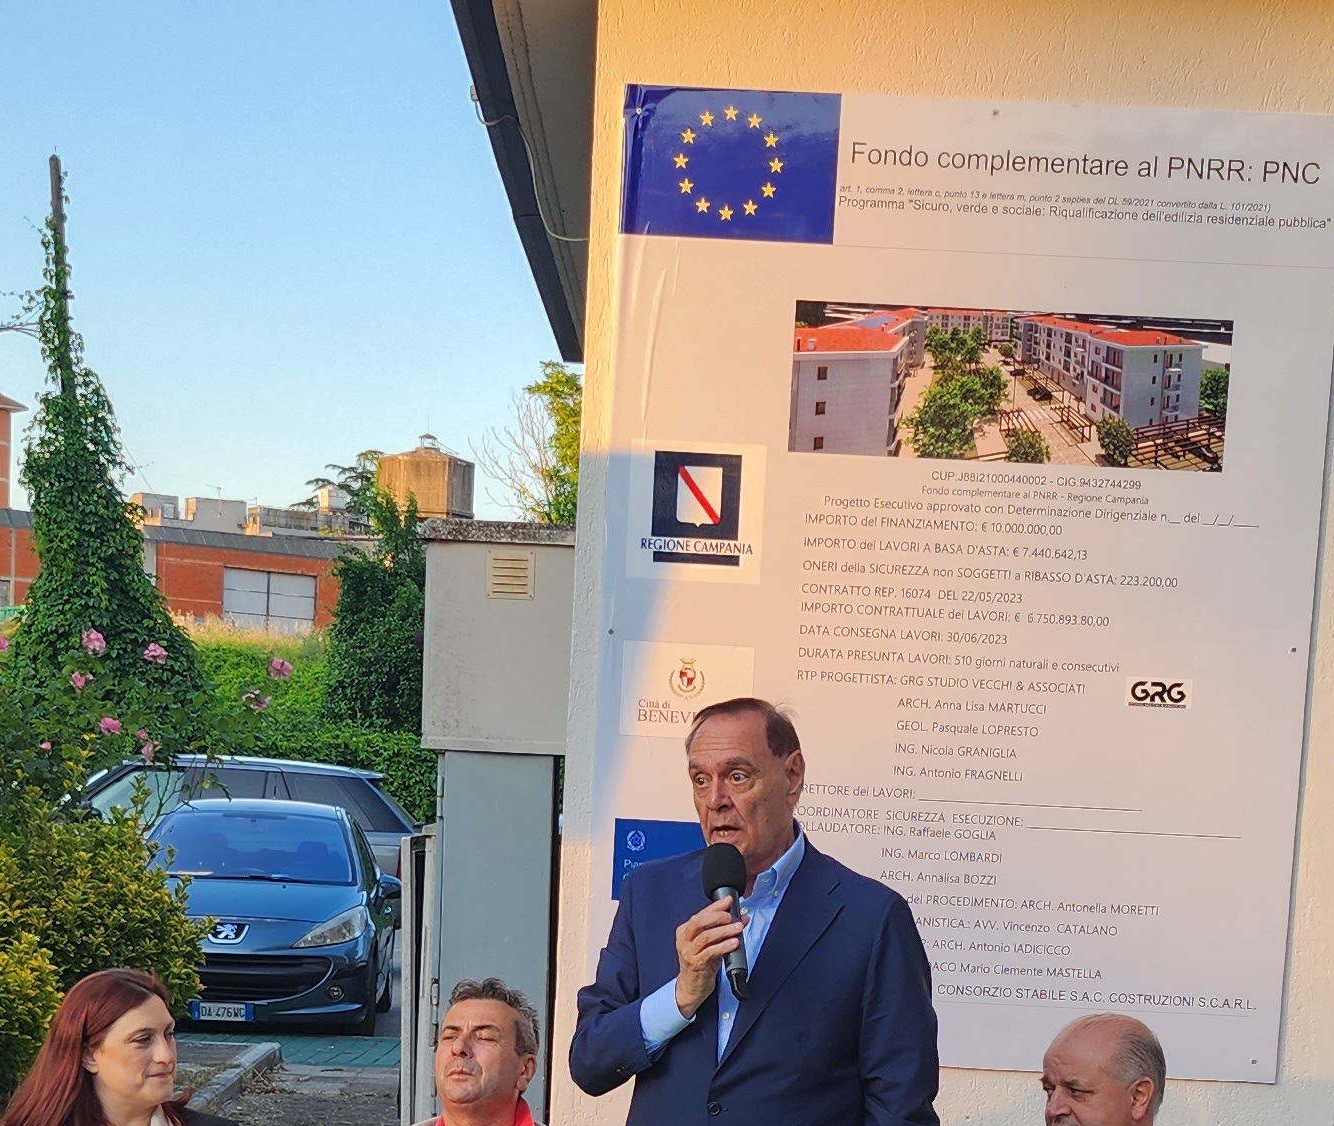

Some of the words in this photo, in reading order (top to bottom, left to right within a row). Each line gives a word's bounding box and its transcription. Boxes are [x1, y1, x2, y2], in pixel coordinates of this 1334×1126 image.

[851, 141, 929, 168] Fondo
[938, 149, 1129, 177] complementare
[1137, 155, 1159, 178] al
[1167, 156, 1253, 182] PNRR:
[1262, 160, 1321, 185] PNC
[944, 190, 968, 200] punto
[1029, 193, 1053, 204] punto
[1157, 199, 1197, 209] convertito
[838, 195, 906, 211] Programma
[909, 198, 953, 213] "Sicuro,
[956, 201, 989, 214] verde
[1002, 203, 1046, 216] sociale:
[1049, 205, 1139, 221] Riqualificazione
[1141, 210, 1203, 224] dell'edilizia
[1206, 212, 1275, 227] residenziale
[1278, 215, 1332, 229] pubblica"
[921, 485, 950, 496] Fondo
[952, 487, 1020, 500] complementare
[1033, 491, 1058, 501] PNRR
[1067, 493, 1103, 505] Regione
[1105, 494, 1149, 506] Campania
[824, 495, 870, 511] Progetto
[873, 497, 923, 511] Esecutivo
[926, 500, 982, 515] approvato
[984, 504, 1004, 515] con
[1007, 504, 1092, 519] Determinazione
[1095, 508, 1157, 523] Dirigenziale
[1183, 512, 1200, 524] del
[805, 513, 858, 526] IMPORTO
[861, 515, 878, 527] del
[880, 517, 978, 533] FINANZIAMENTO:
[991, 521, 1062, 536] 10.000.000,00
[641, 537, 691, 551] REGIONE
[694, 541, 754, 555] CAMPANIA
[803, 537, 857, 550] IMPORTO
[860, 538, 876, 551] dei
[879, 541, 920, 553] LAVORI
[923, 542, 932, 553] A
[934, 542, 964, 555] BASA
[966, 543, 1009, 557] D'ASTA:
[1022, 546, 1087, 560] 7.440.642,13
[803, 560, 838, 572] ONERI
[840, 561, 866, 574] della
[869, 563, 929, 576] SICUREZZA
[933, 568, 953, 578] non
[957, 567, 1011, 580] SOGGETTI
[1024, 571, 1071, 583] RIBASSO
[1074, 573, 1117, 586] D'ASTA:
[1120, 575, 1178, 589] 223.200,00
[801, 583, 871, 597] CONTRATTO
[874, 586, 898, 598] REP.
[901, 587, 931, 599] 16074
[938, 589, 958, 602] DEL
[961, 589, 1023, 604] 22/05/2023
[800, 601, 854, 615] IMPORTO
[856, 604, 945, 619] CONTRATTUALE
[947, 608, 964, 620] dei
[967, 610, 1011, 622] LAVORI:
[1027, 612, 1110, 627] 6.750.893.80,00
[799, 624, 830, 637] DATA
[833, 626, 897, 640] CONSEGNA
[900, 629, 943, 642] LAVORI:
[946, 631, 1008, 645] 30/06/2023
[798, 647, 844, 660] DURATA
[847, 650, 905, 663] PRESUNTA
[908, 653, 952, 665] LAVORI:
[954, 655, 973, 666] 510
[975, 656, 1006, 670] giorni
[1009, 658, 1049, 671] naturali
[1061, 661, 1120, 674] consecutivi
[797, 670, 817, 681] RTP
[820, 671, 897, 685] PROGETTISTA:
[900, 675, 924, 687] GRG
[927, 676, 969, 688] STUDIO
[972, 678, 1012, 691] VECCHI
[1027, 681, 1086, 695] ASSOCIATI
[1130, 680, 1187, 704] GRG
[638, 699, 659, 709] Città
[661, 699, 671, 709] di
[897, 698, 932, 710] ARCH.
[934, 699, 962, 711] Anna
[965, 700, 985, 712] Lisa
[988, 702, 1047, 715] MARTUCCI
[896, 720, 928, 732] GEOL.
[931, 721, 978, 736] Pasquale
[981, 724, 1039, 738] LOPRESTO
[894, 743, 918, 754] ING.
[921, 744, 954, 756] Nicola
[957, 746, 1017, 759] GRANIGLIA
[893, 765, 916, 777] ING.
[919, 767, 961, 779] Antonio
[964, 769, 1023, 782] FRAGNELLI
[852, 786, 869, 798] dei
[872, 787, 916, 800] LAVORI:
[885, 810, 946, 823] SICUREZZA
[951, 814, 1024, 828] ESECUZIONE:
[883, 825, 906, 837] ING.
[909, 826, 951, 839] Raffaele
[953, 828, 996, 841] GOGLIA
[880, 848, 905, 859] ING.
[907, 849, 941, 861] Marco
[944, 850, 1003, 864] LOMBARDI
[880, 870, 914, 882] ARCH.
[917, 872, 960, 884] Annalisa
[963, 874, 997, 886] BOZZI
[926, 894, 1017, 910] PROCEDIMENTO:
[1020, 899, 1054, 911] ARCH.
[1056, 901, 1106, 914] Antonella
[1110, 904, 1159, 916] MORETTI
[973, 919, 999, 931] AVV.
[1002, 920, 1050, 933] Vincenzo
[1056, 923, 1118, 936] CATALANO
[932, 939, 965, 950] ARCH.
[969, 941, 1010, 953] Antonio
[1013, 943, 1071, 956] IADICICCO
[960, 963, 990, 974] Mario
[993, 964, 1043, 977] Clemente
[1046, 967, 1102, 980] MASTELLA
[937, 984, 1012, 998] CONSORZIO
[1015, 987, 1067, 1001] STABILE
[1070, 990, 1105, 1003] S.A.C.
[1109, 992, 1195, 1007] COSTRUZIONI
[200, 1005, 213, 1018] DA
